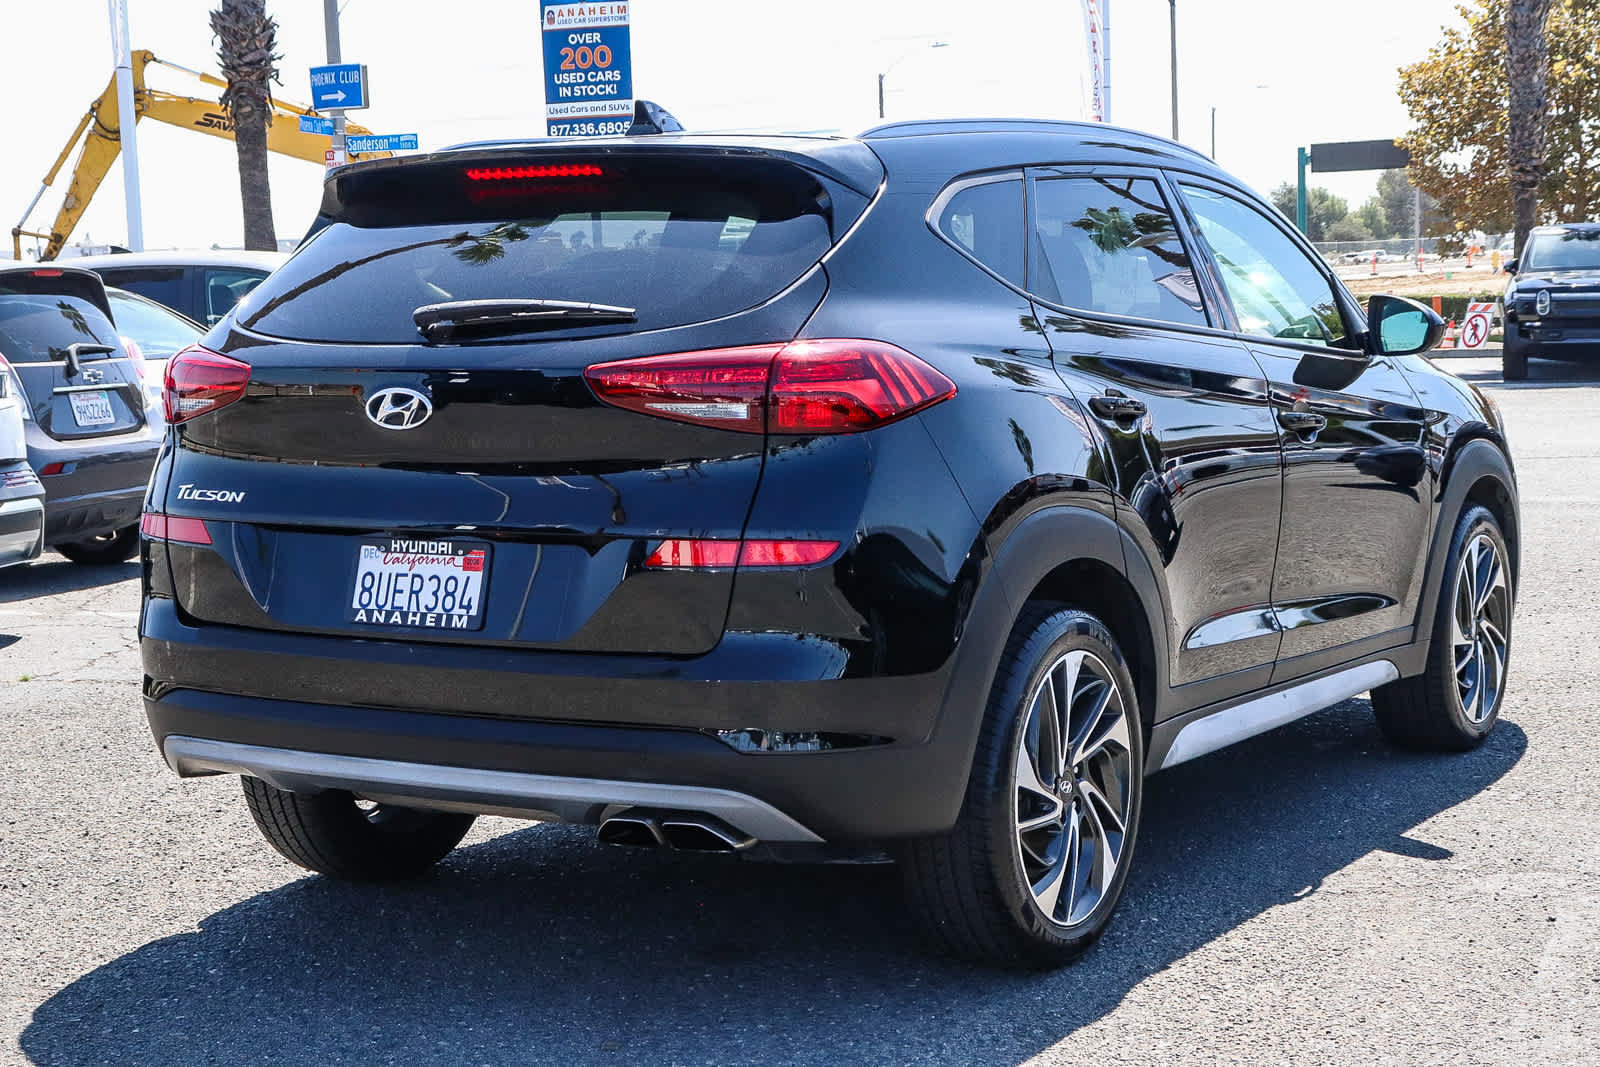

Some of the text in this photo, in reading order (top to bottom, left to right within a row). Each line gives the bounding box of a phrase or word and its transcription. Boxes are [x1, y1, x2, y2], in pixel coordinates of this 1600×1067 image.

[557, 5, 627, 17] ANAHEIM
[587, 15, 627, 23] SUPERSTORE
[568, 32, 601, 45] OVER
[560, 45, 612, 70] 200
[311, 70, 360, 87] PHOENIX CLUB
[553, 70, 621, 84] USED CARS
[559, 83, 618, 97] IN STOCK!
[549, 103, 630, 115] Used Cars and SUVs
[194, 113, 233, 132] SAV
[550, 121, 631, 136] 877.336.6805
[347, 137, 389, 151] Sanderson
[364, 547, 380, 559] DEC
[391, 540, 452, 554] HYUNDAI
[383, 552, 463, 571] California
[358, 571, 473, 615] 8UER384
[354, 609, 468, 629] ANAHEIM
